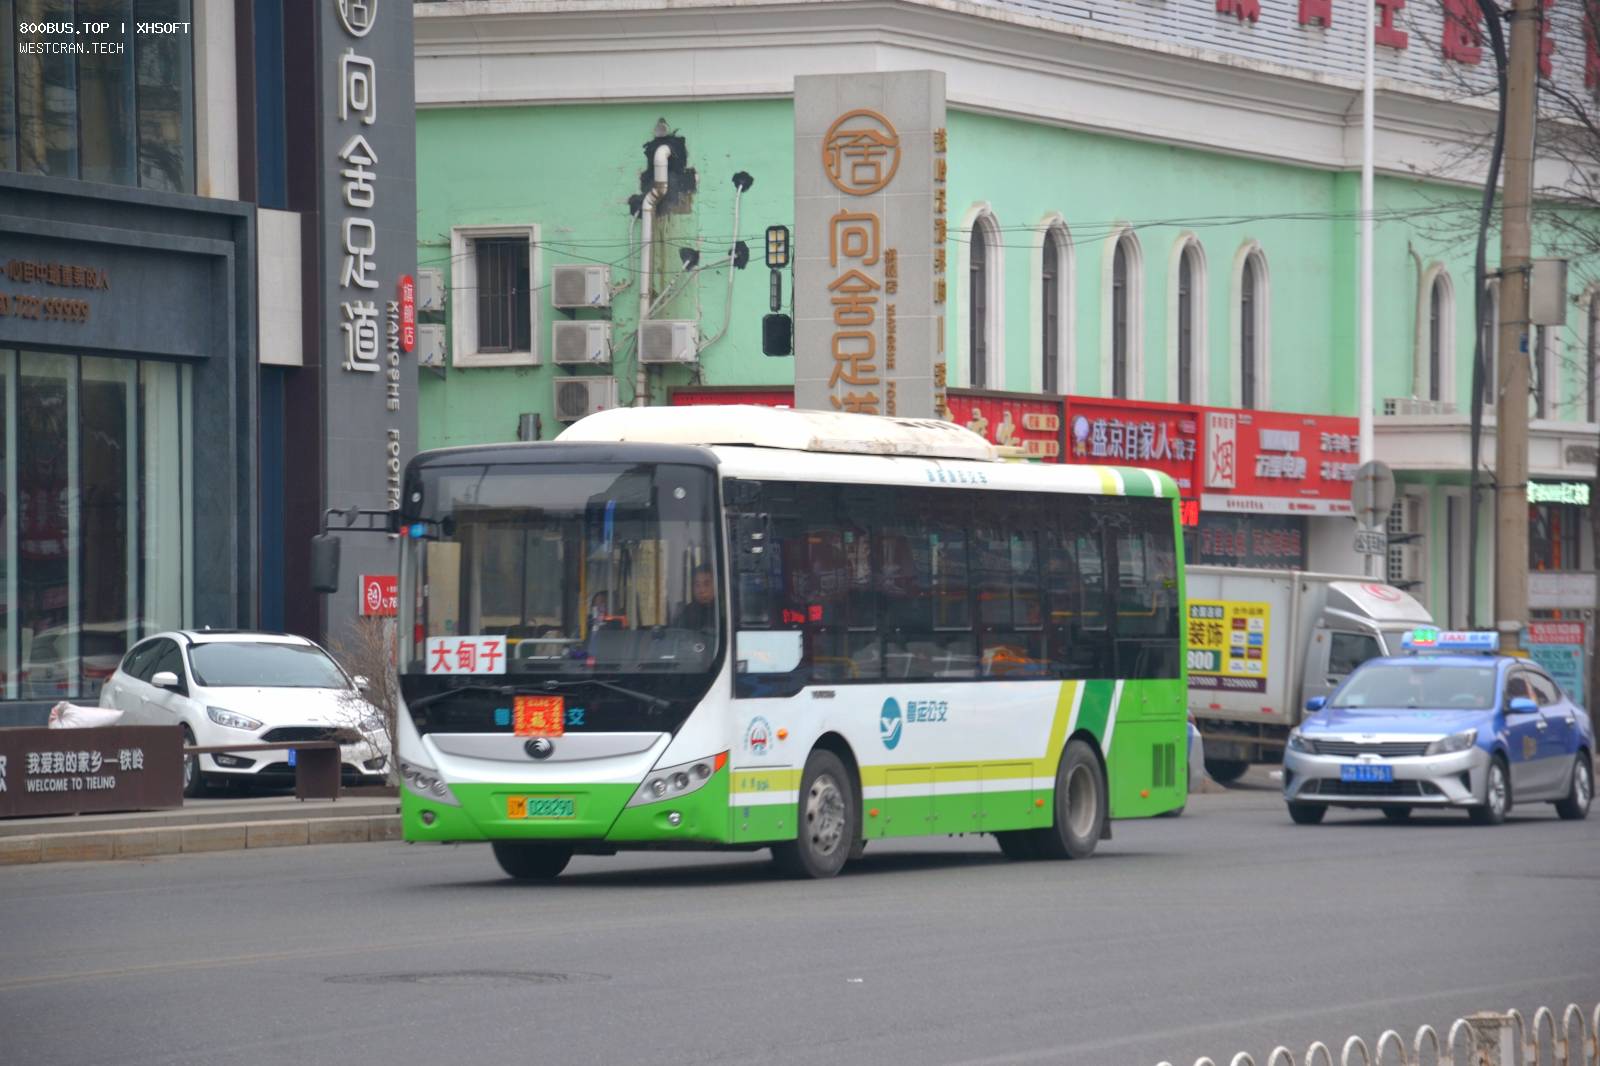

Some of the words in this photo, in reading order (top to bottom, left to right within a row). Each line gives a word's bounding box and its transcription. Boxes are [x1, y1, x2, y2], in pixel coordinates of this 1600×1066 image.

[338, 47, 381, 373] 向舍足道
[387, 300, 401, 412] XIANGSHE
[1091, 417, 1172, 461] 盛京自家人
[1211, 433, 1234, 485] 烟
[431, 640, 503, 673] 大甸子
[26, 778, 68, 792] WELCOME
[71, 777, 83, 790] TO
[86, 775, 116, 789] TIELING
